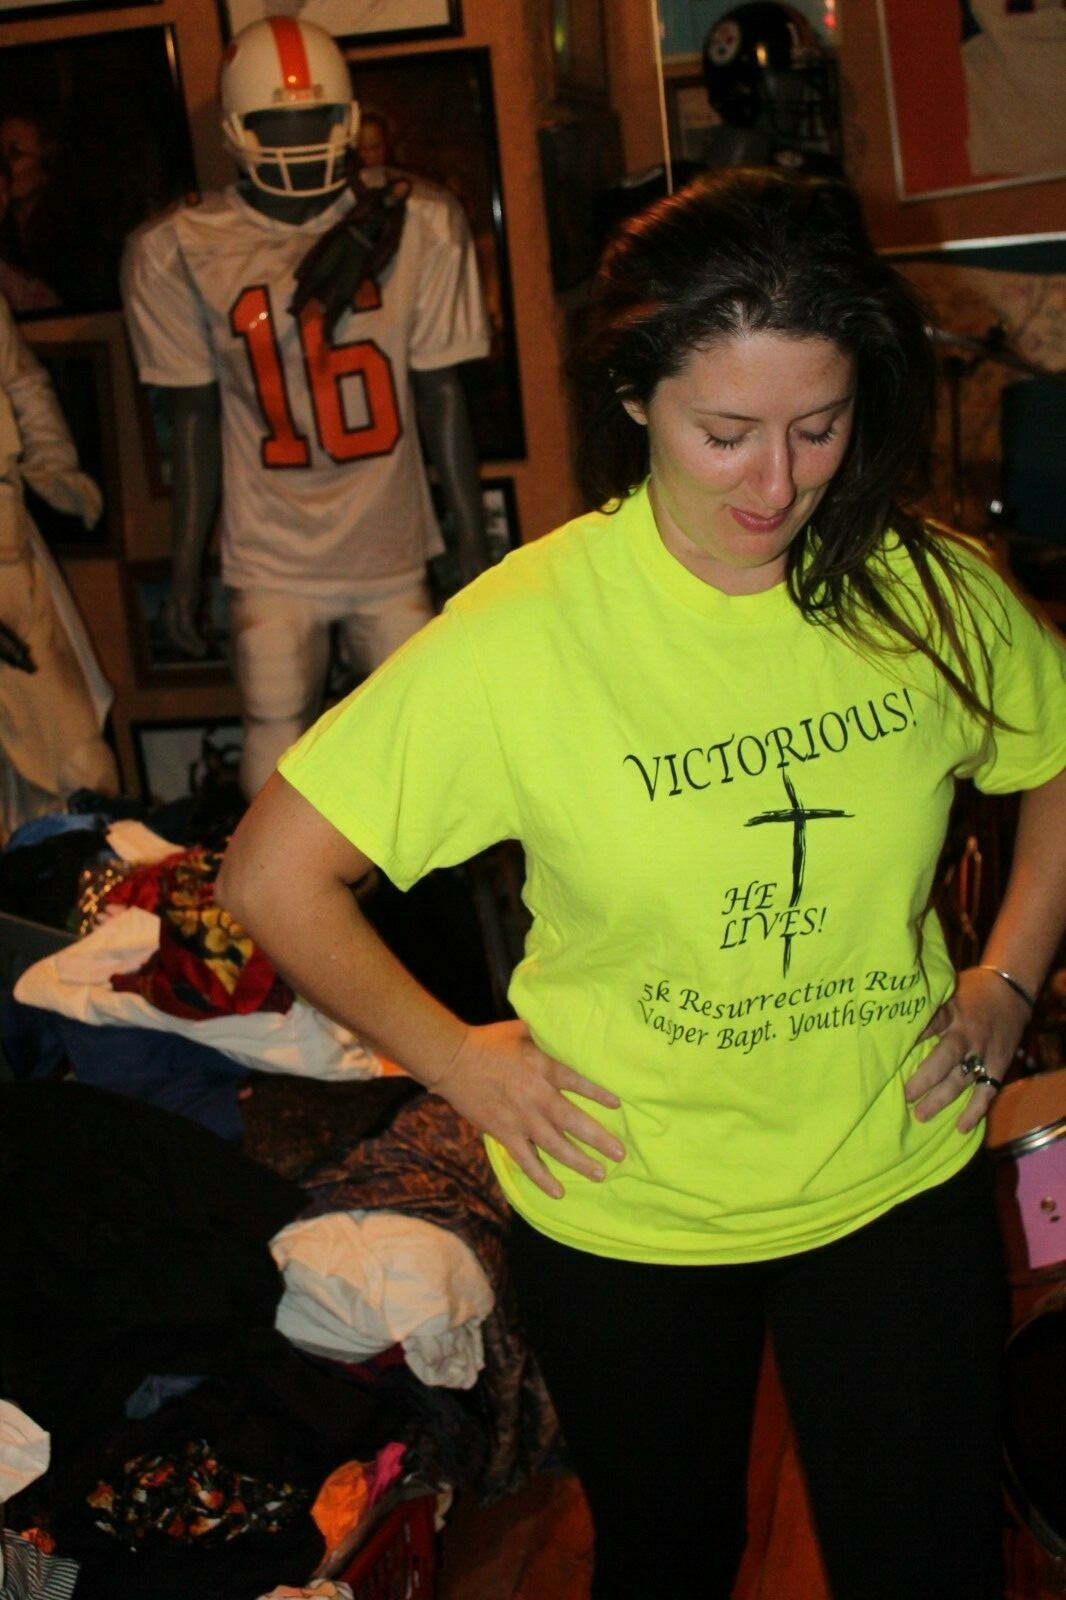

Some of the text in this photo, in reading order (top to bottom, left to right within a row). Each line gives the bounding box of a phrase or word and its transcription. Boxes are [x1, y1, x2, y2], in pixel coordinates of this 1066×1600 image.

[230, 278, 403, 469] 16
[623, 688, 919, 802] VICTORIOUS!
[721, 880, 777, 915] HE
[719, 907, 827, 949] LIVES!
[641, 969, 921, 1020] 5k Resurrection Run
[636, 999, 709, 1046] Vasper
[716, 1021, 777, 1055] Bapt.
